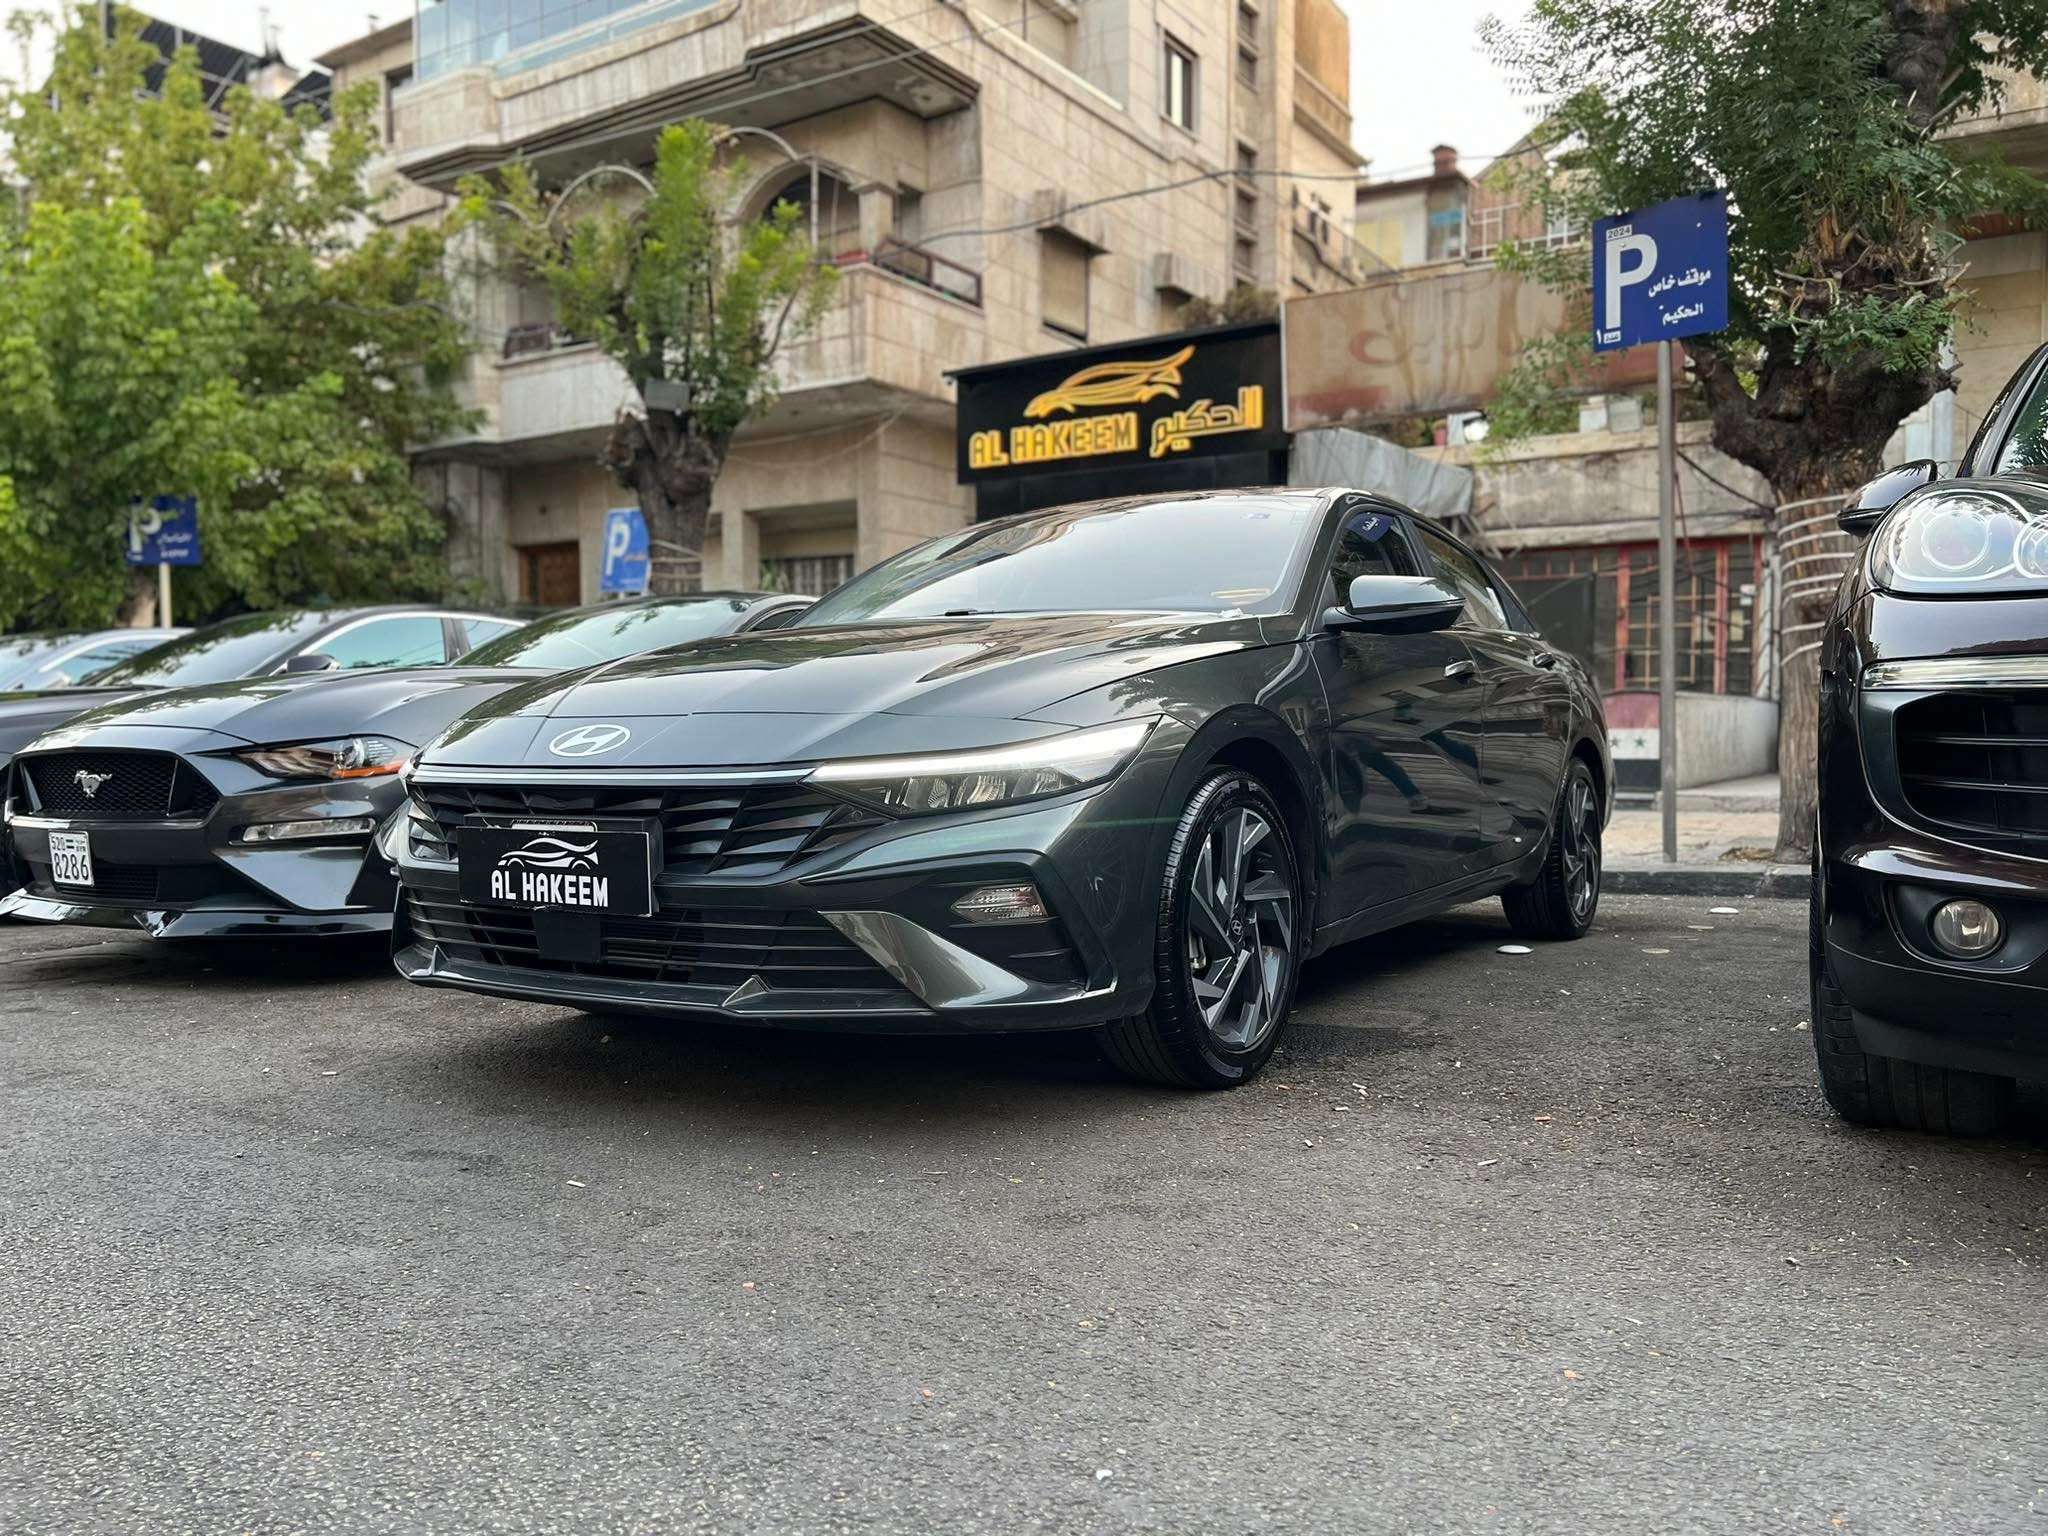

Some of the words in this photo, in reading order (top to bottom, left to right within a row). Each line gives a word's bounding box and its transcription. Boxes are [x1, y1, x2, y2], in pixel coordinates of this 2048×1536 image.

[1607, 226, 1631, 239] 2024
[1606, 233, 1658, 330] P
[1648, 273, 1677, 298] خاص
[1678, 267, 1712, 286] موقف
[1662, 302, 1704, 326] الحكيم
[969, 430, 1009, 469] AL
[1010, 411, 1138, 465] HAKEEM
[1149, 385, 1263, 458] الحكيم
[129, 505, 162, 553] P
[606, 520, 631, 576] P
[54, 852, 89, 881] 8286
[491, 869, 516, 900] AL
[522, 871, 608, 907] HAKEEM
